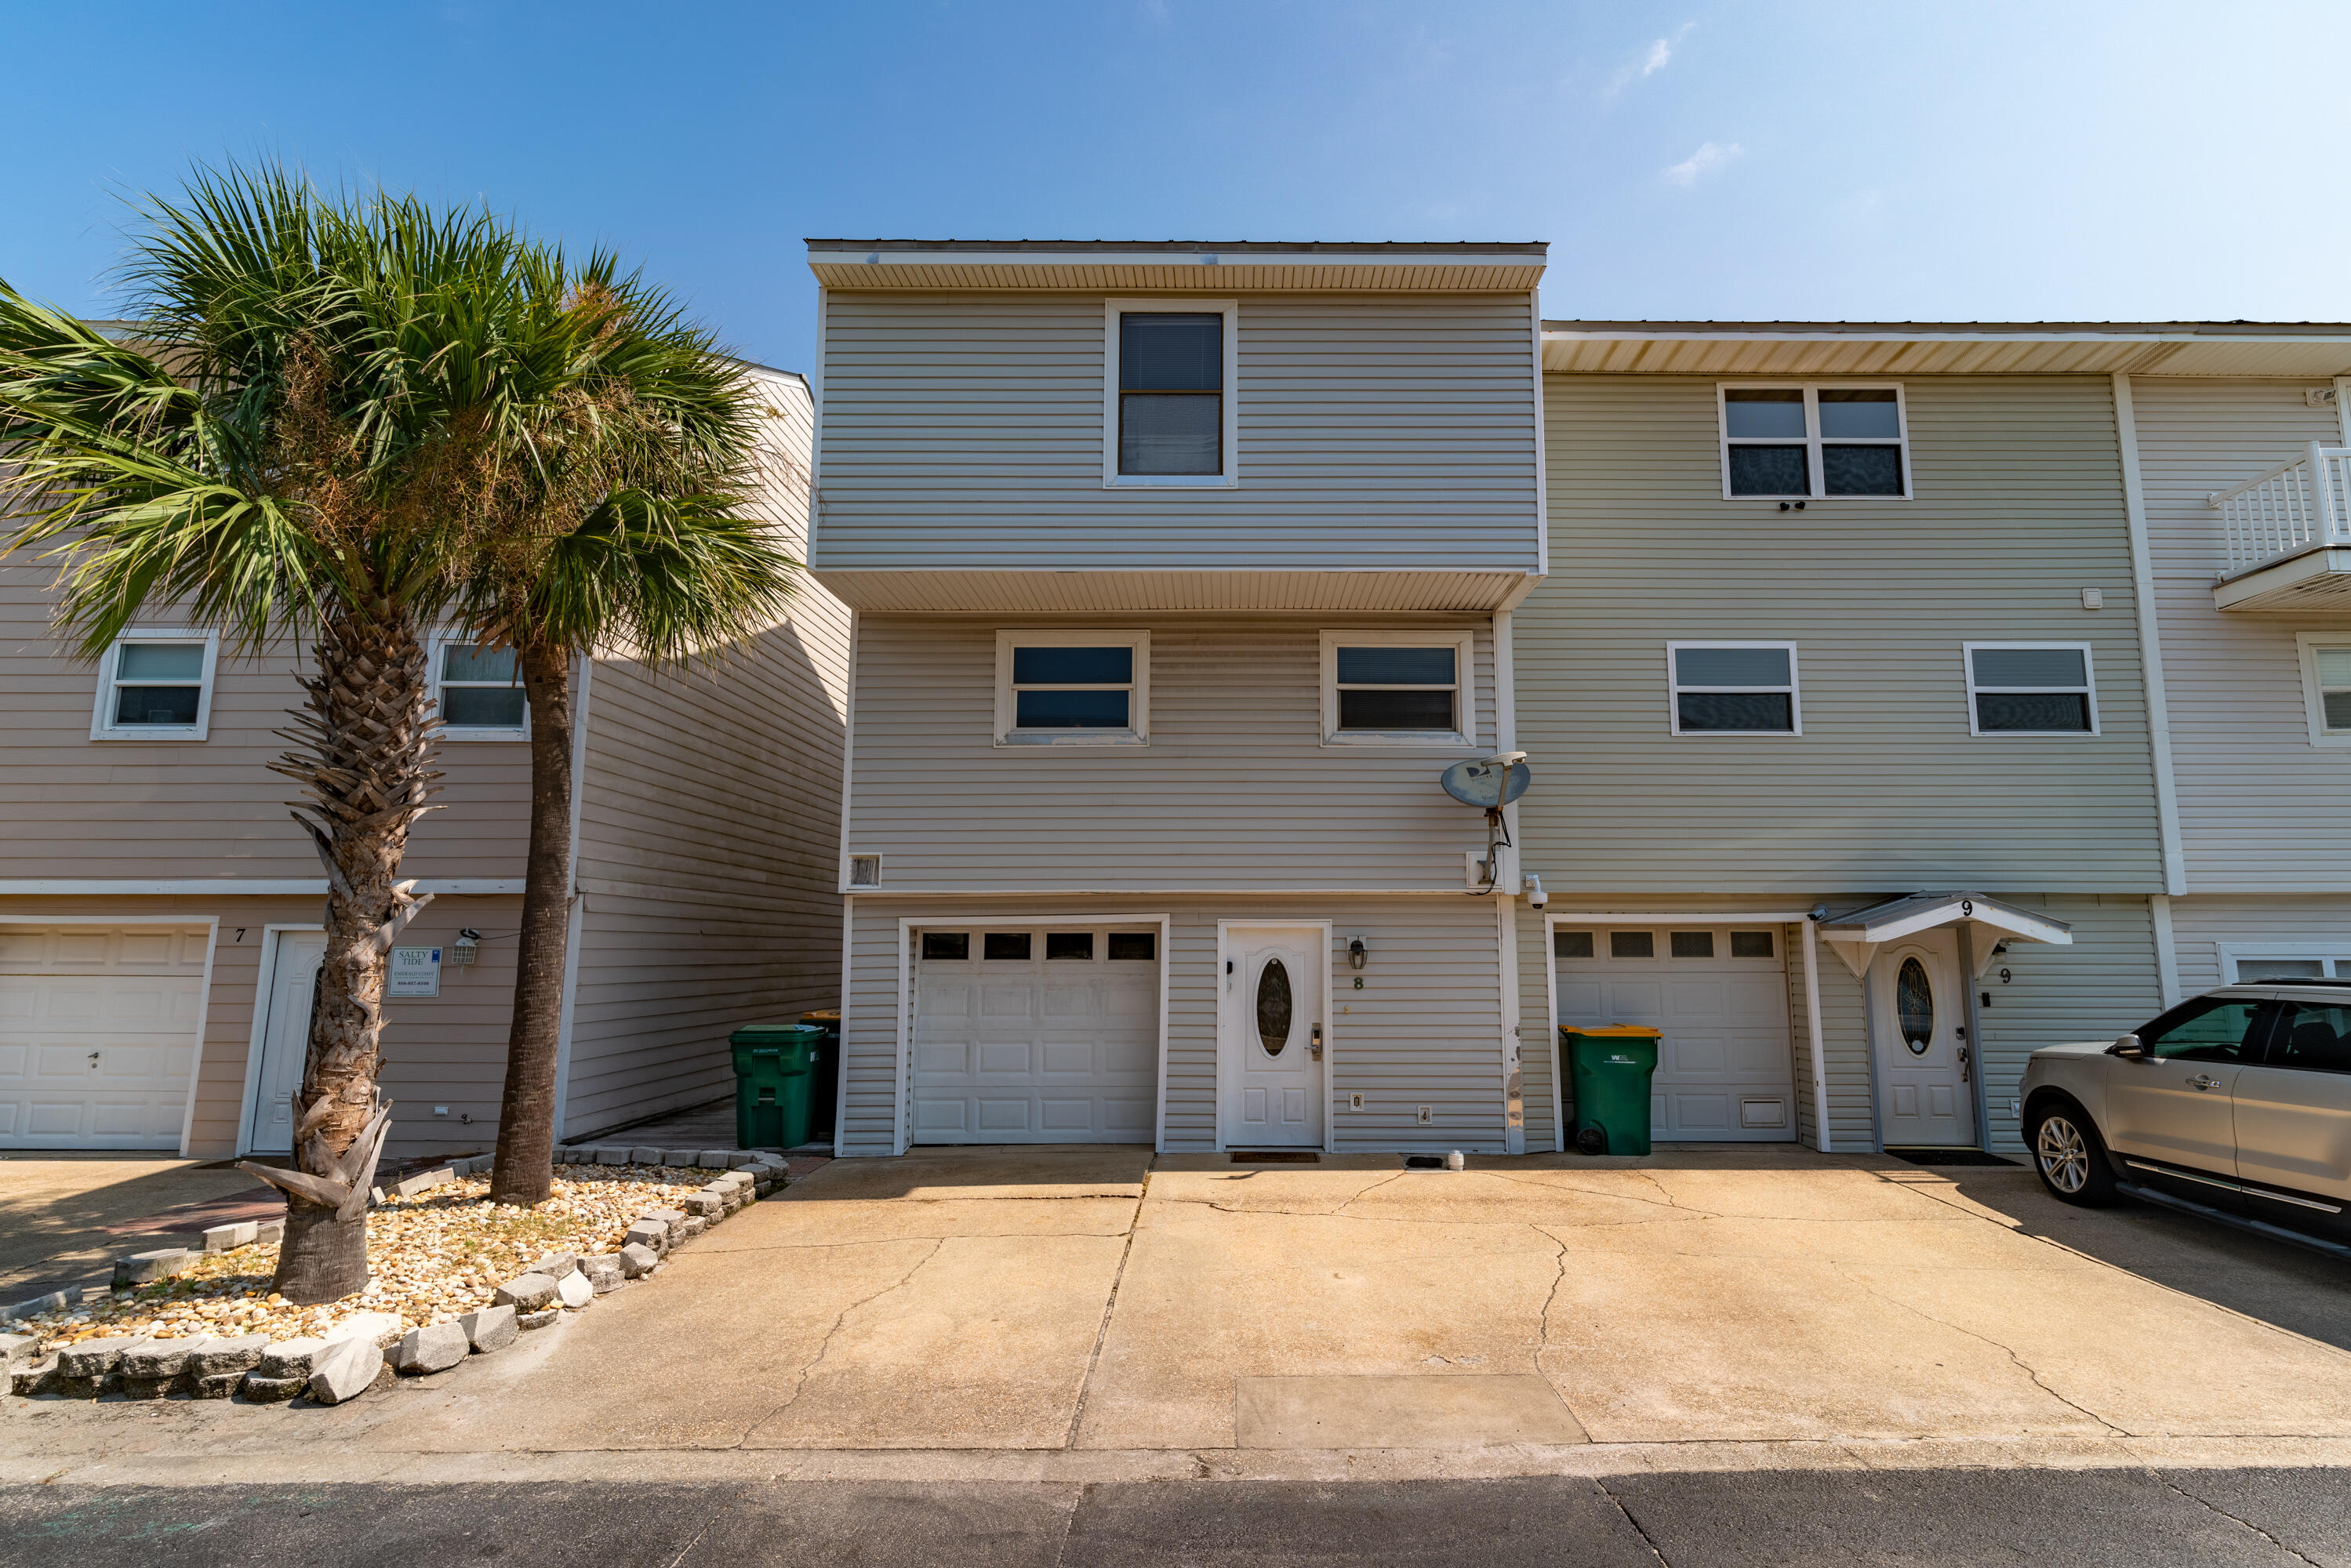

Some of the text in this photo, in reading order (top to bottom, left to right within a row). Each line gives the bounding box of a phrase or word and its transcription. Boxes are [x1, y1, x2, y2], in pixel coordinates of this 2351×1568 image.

[1962, 900, 1972, 916] 9
[236, 928, 246, 942] 7
[1354, 977, 1364, 989] 8
[2000, 968, 2011, 984] 9
